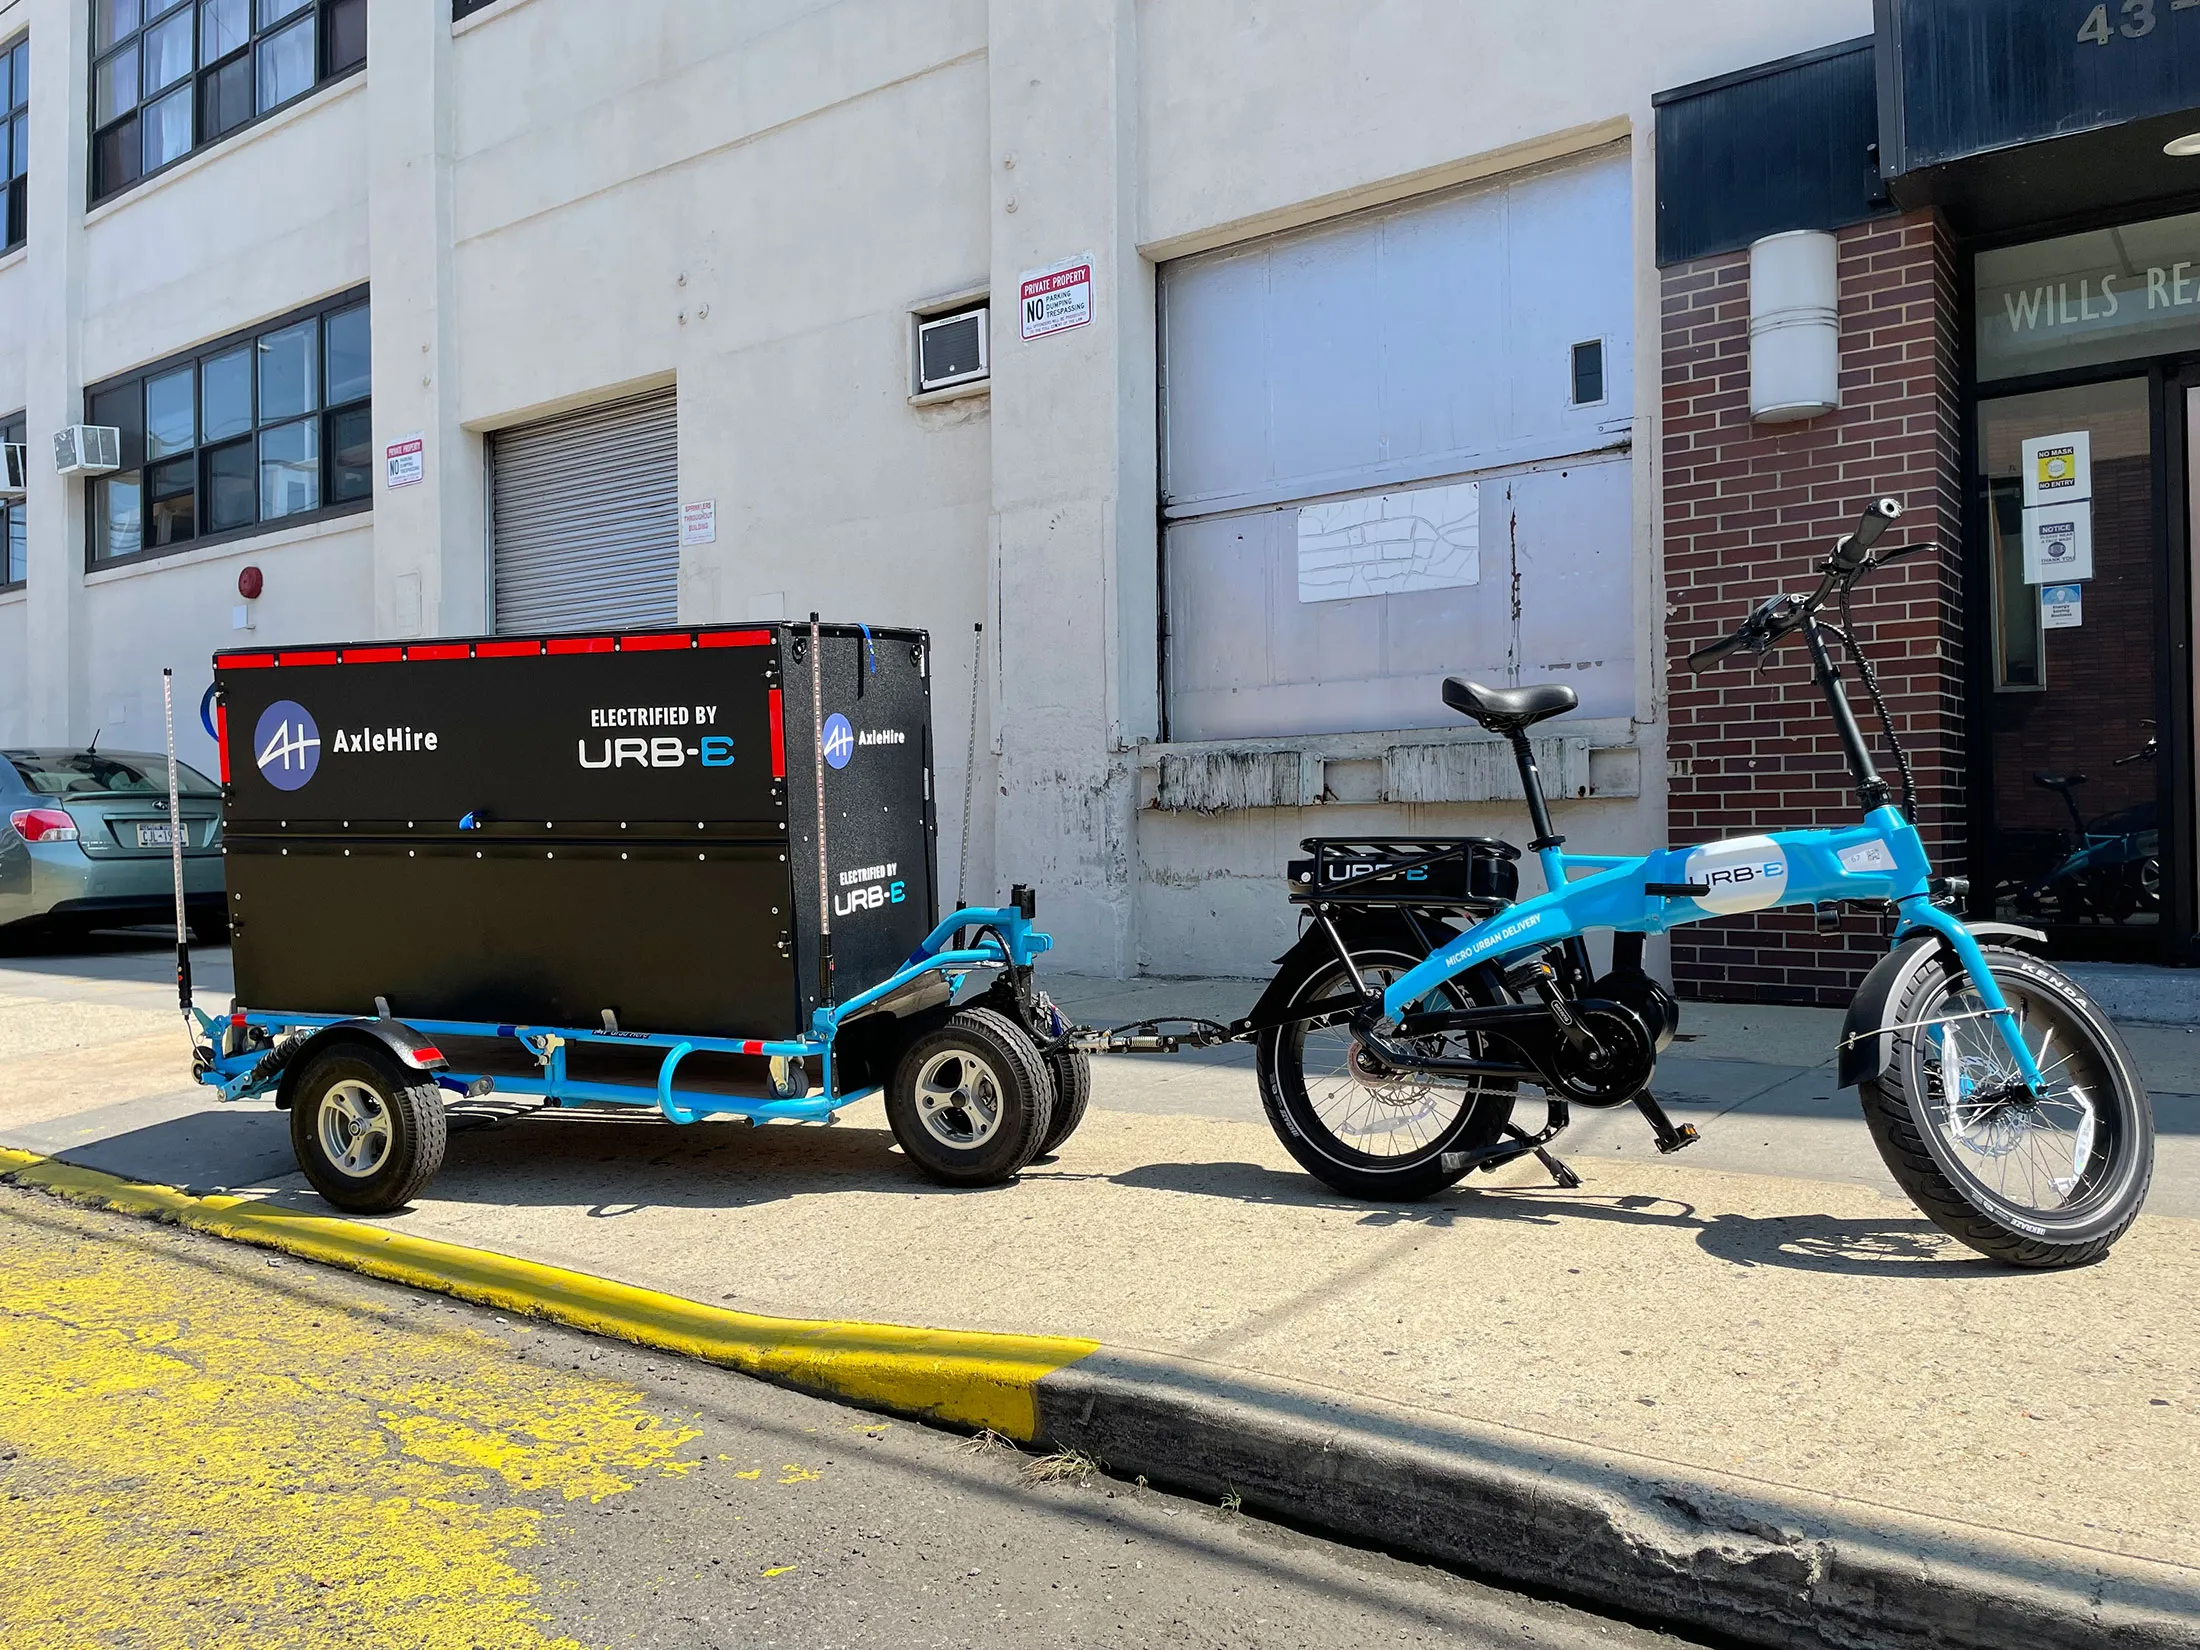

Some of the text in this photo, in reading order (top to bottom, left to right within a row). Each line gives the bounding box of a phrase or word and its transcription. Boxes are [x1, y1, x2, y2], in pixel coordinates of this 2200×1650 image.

[1024, 268, 1086, 296] PRIVATE PROPERTY
[1045, 290, 1072, 302] PARKING
[1045, 298, 1072, 311] DUMPING
[2003, 261, 2200, 332] WILLS RE
[1026, 298, 1044, 323] NO
[1046, 302, 1085, 318] TRESPASSING
[2051, 447, 2073, 456] MASK
[389, 459, 400, 476] NO
[2051, 479, 2074, 488] ENTRY
[688, 522, 709, 532] BUILDING
[2042, 524, 2071, 534] NOTICE
[591, 705, 718, 728] ELECTRIFIED BY
[333, 726, 438, 753] AxleHire
[858, 729, 905, 746] AxleHire
[578, 736, 735, 769] URB-E
[839, 862, 898, 886] ELECTRIFIED BY
[834, 880, 906, 917] URB-E
[1445, 913, 1541, 968] MICRO URBAN DELIVERY
[2021, 962, 2088, 1009] KENDA
